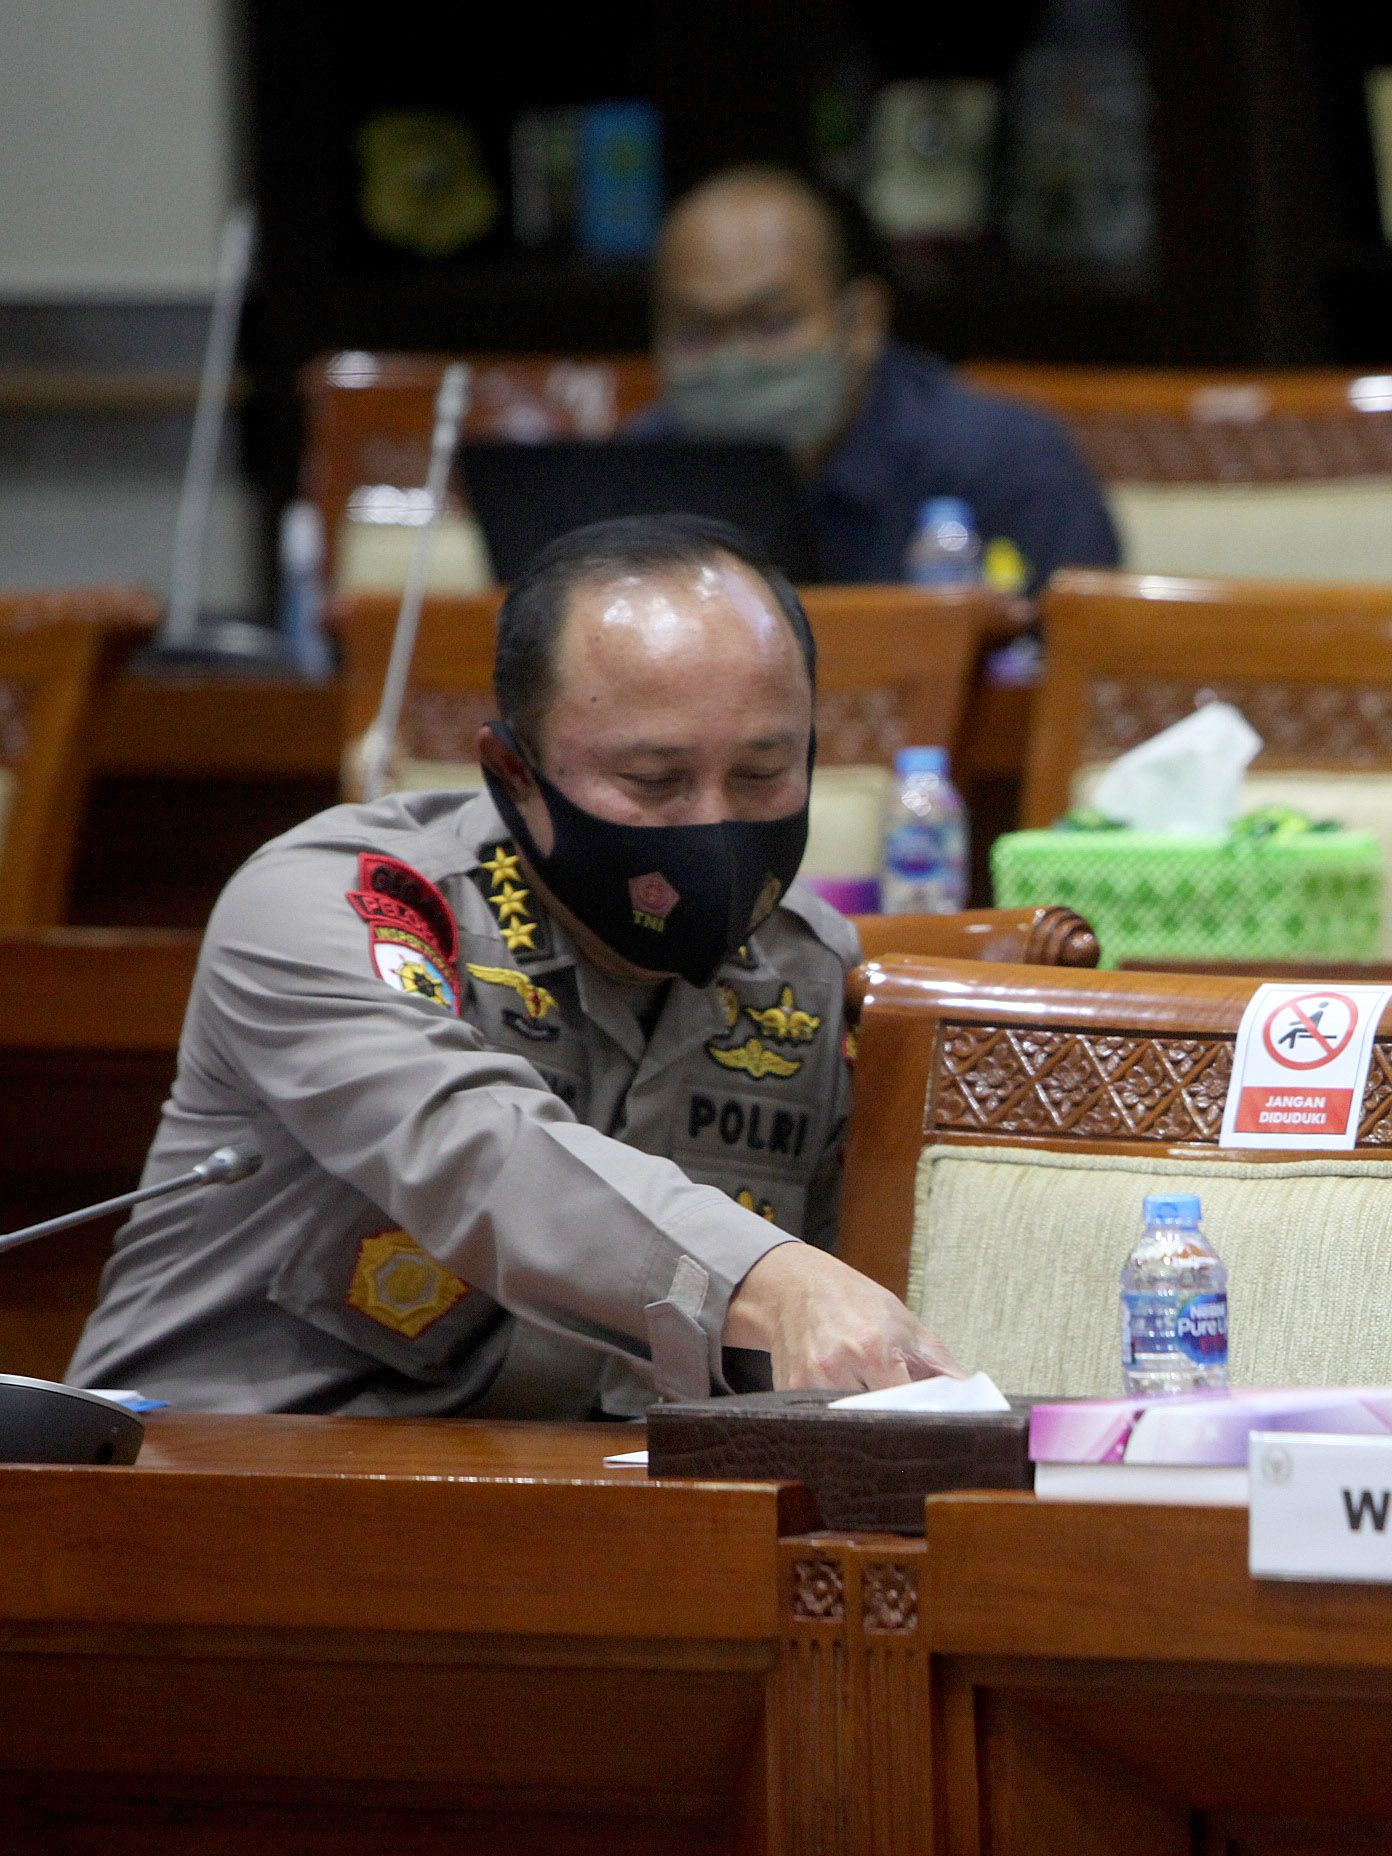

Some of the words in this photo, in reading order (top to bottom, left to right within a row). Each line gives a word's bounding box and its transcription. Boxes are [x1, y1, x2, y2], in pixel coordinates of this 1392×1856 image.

[1265, 1096, 1327, 1109] JANGAN
[688, 1094, 809, 1156] POLRI
[1258, 1111, 1327, 1125] DIDUDUKI
